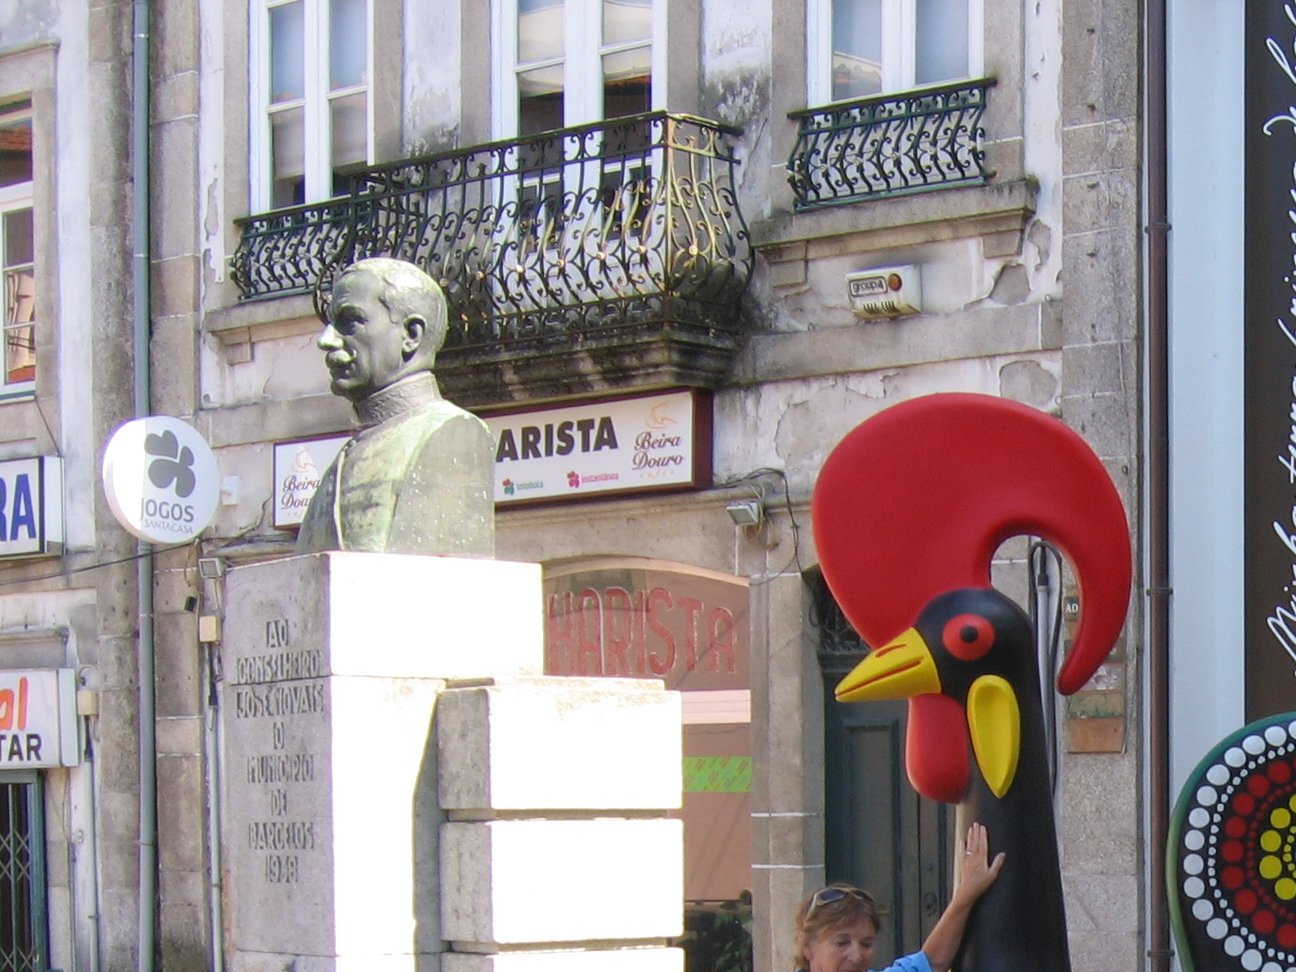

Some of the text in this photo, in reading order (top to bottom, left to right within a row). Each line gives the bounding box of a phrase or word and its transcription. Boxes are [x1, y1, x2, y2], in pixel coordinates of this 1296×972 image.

[634, 431, 681, 450] Beira
[631, 451, 685, 470] Douro
[140, 497, 194, 523] JOGOS
